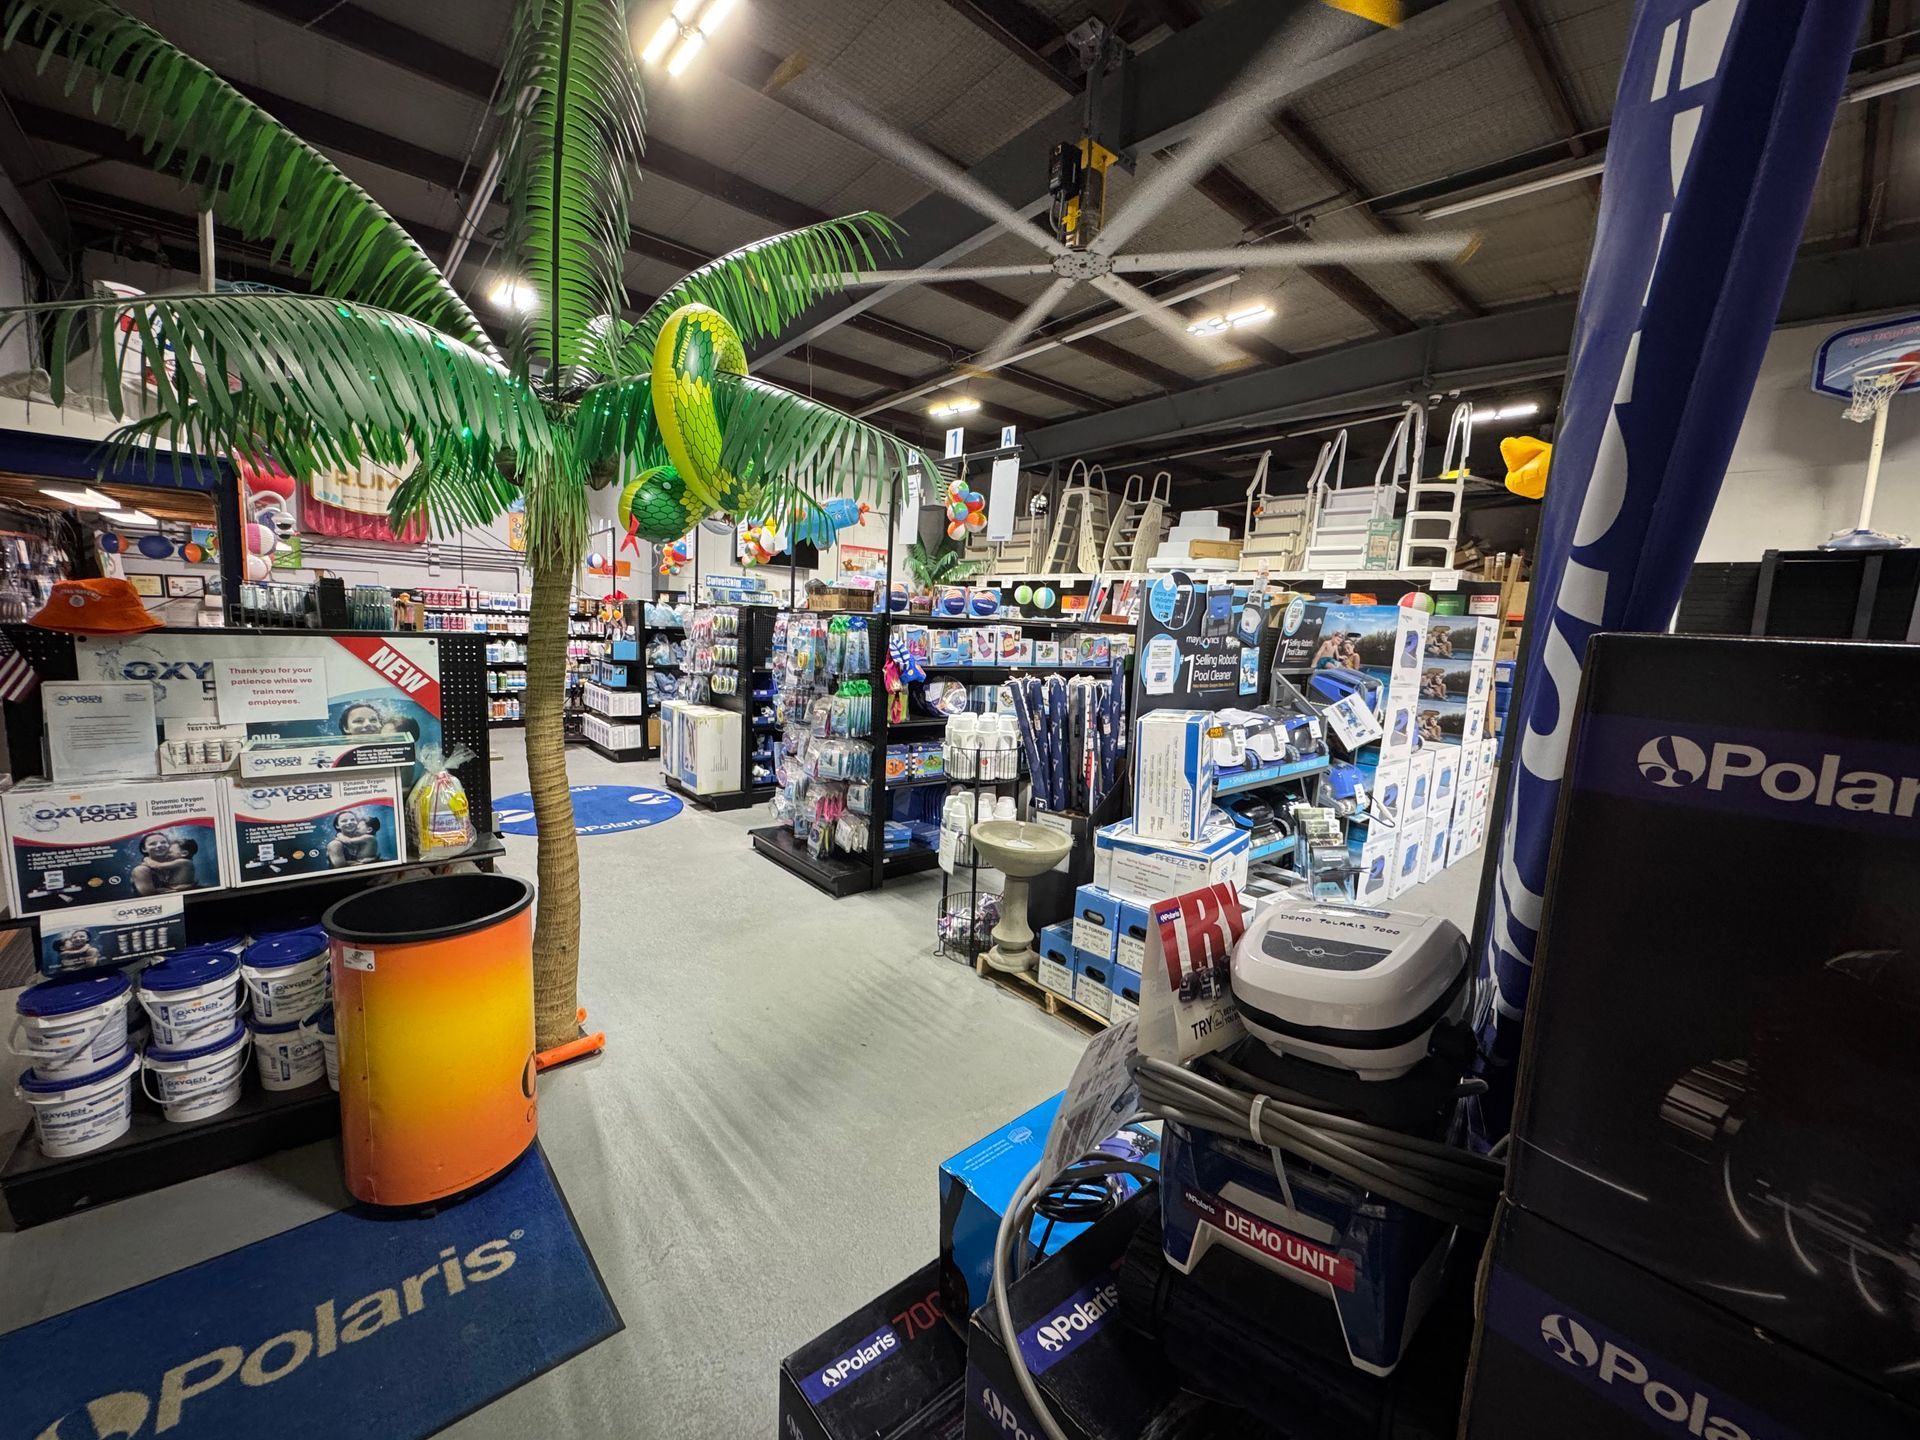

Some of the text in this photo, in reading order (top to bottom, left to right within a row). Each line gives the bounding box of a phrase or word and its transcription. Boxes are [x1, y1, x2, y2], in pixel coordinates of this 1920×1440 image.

[951, 430, 959, 455] 1
[1003, 428, 1012, 447] A
[1195, 654, 1239, 668] Selling Robotic
[259, 668, 276, 676] you
[292, 667, 313, 676] your
[368, 645, 431, 694] NEW
[1193, 670, 1232, 681] Pool Cleaner
[230, 677, 272, 686] patience
[273, 677, 298, 685] while
[252, 687, 274, 695] train
[247, 698, 301, 707] employees.
[254, 755, 302, 767] OXYGEN
[251, 783, 332, 799] OXYGEN
[286, 793, 333, 803] POOLS
[343, 789, 373, 797] Residential
[150, 795, 205, 806] Dynamic Oxygen
[151, 801, 196, 811] Generator For
[1183, 788, 1191, 821] BREEZE
[35, 801, 138, 820] OXYGEN
[151, 805, 207, 817] Residential Pools
[79, 811, 138, 825] POOLS
[584, 818, 651, 833] Polaris
[118, 904, 162, 917] OXYGEN
[1163, 909, 1181, 921] Polaris
[1075, 922, 1110, 938] BLUE TORRENT
[1280, 913, 1401, 936] DEMO POLARIS 7000
[1120, 938, 1134, 948] BLUE
[1041, 960, 1071, 977] BLUE TORRENT
[1079, 977, 1110, 997] BLUE TORRENT
[176, 1001, 218, 1017] OXYGEN
[1114, 998, 1128, 1009] BLUE
[1190, 1015, 1213, 1041] TRY
[165, 1074, 207, 1088] OXYGEN
[41, 1106, 87, 1120] OXYGEN
[1189, 1194, 1216, 1216] Polaris
[1225, 1209, 1340, 1277] DEMO UNIT
[1051, 1285, 1119, 1343] Polaris
[155, 1238, 518, 1435] Polaris
[836, 1332, 897, 1380] Polaris
